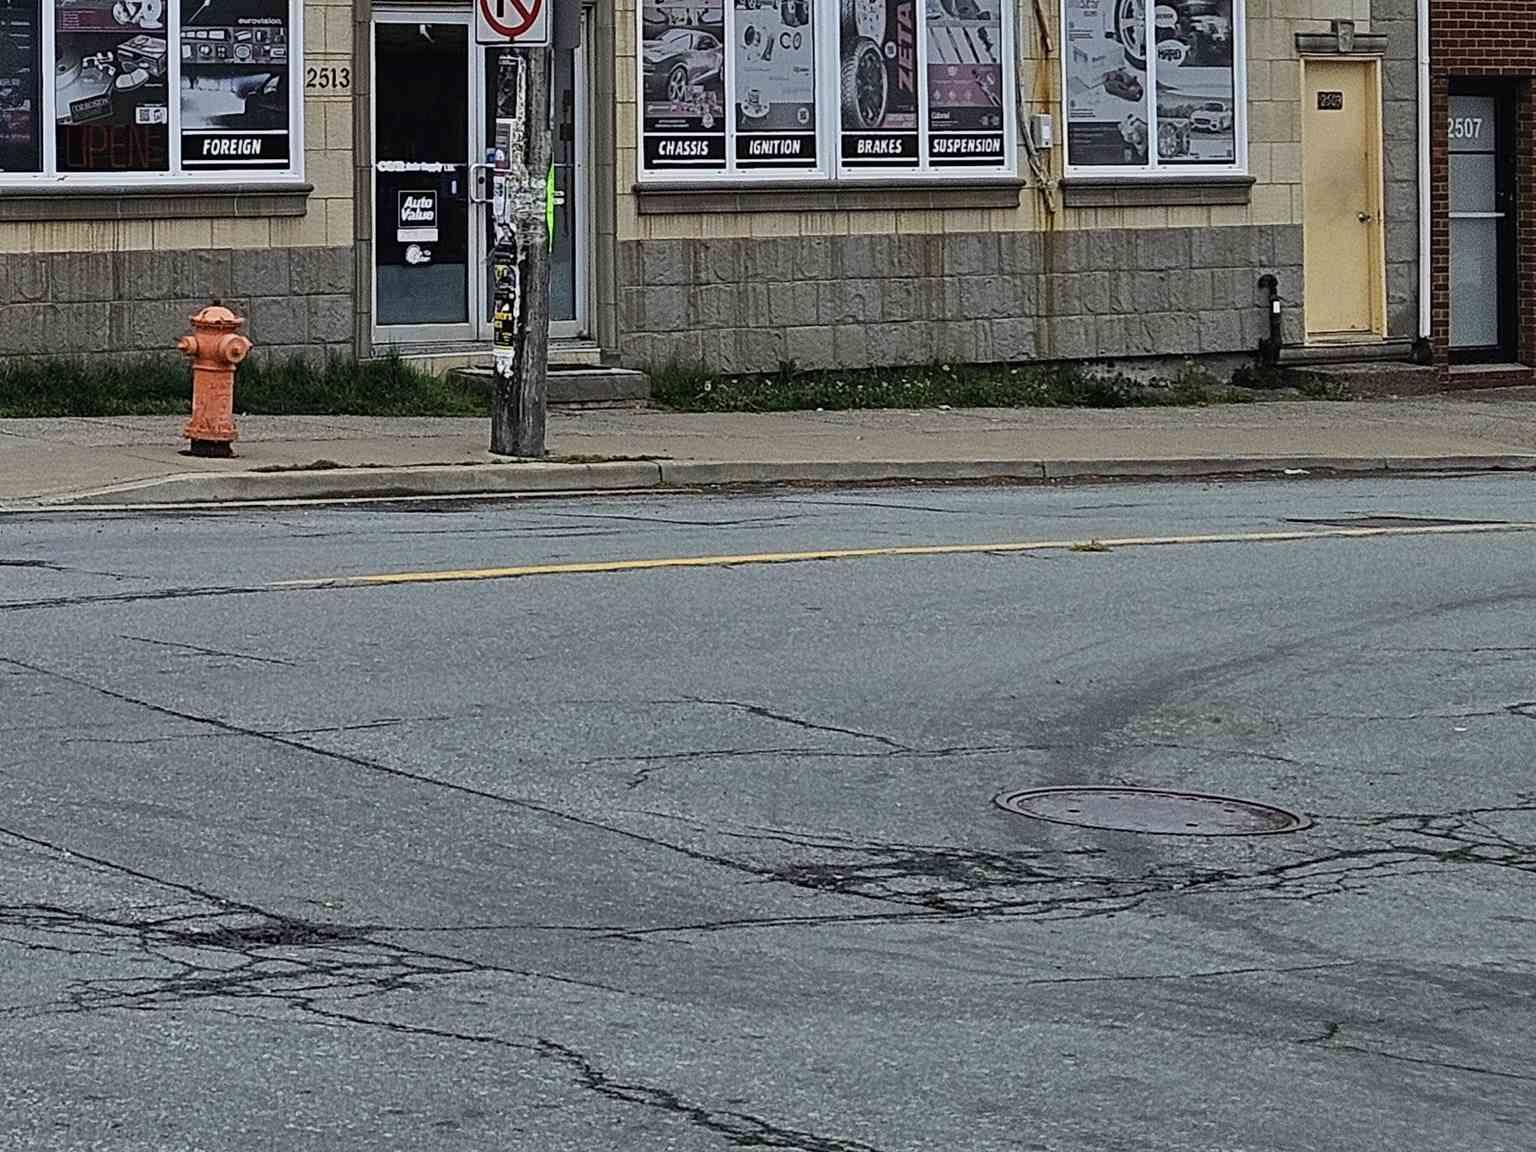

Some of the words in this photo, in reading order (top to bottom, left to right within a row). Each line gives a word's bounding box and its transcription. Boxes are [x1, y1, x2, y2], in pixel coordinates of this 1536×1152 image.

[896, 2, 913, 92] ZETA
[306, 67, 351, 89] 2513
[1448, 118, 1482, 139] 2507
[202, 139, 262, 156] FOREIGN
[658, 140, 710, 156] CHASSIS
[748, 139, 801, 155] IGNITION
[857, 139, 903, 154] BRAKES
[932, 138, 1001, 153] SUSPENSION
[403, 196, 433, 208] Auto
[401, 207, 434, 221] Value
